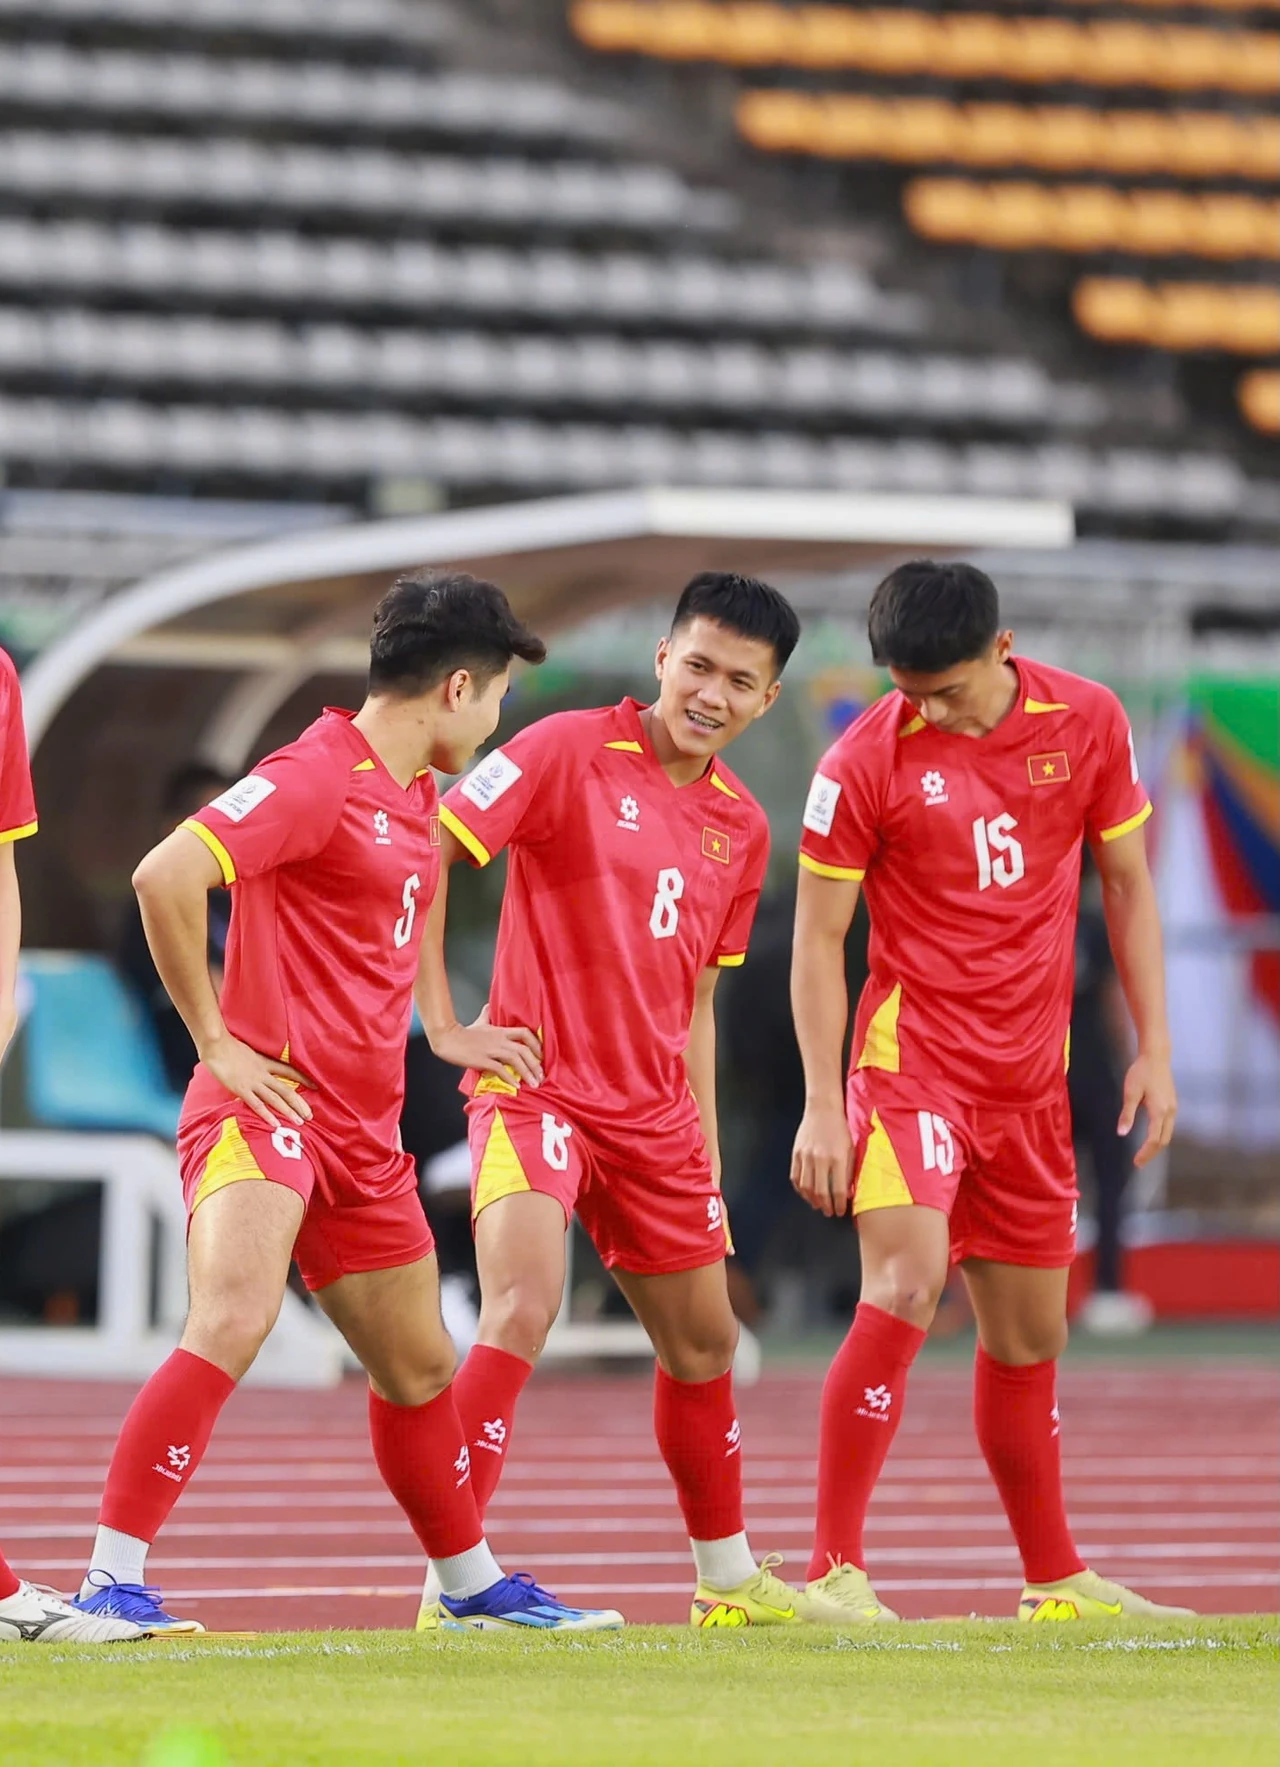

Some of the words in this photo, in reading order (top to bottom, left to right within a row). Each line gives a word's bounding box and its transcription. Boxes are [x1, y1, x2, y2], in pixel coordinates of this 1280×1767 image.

[972, 812, 1025, 892] 15
[393, 873, 421, 949] 5
[649, 867, 685, 940] 8
